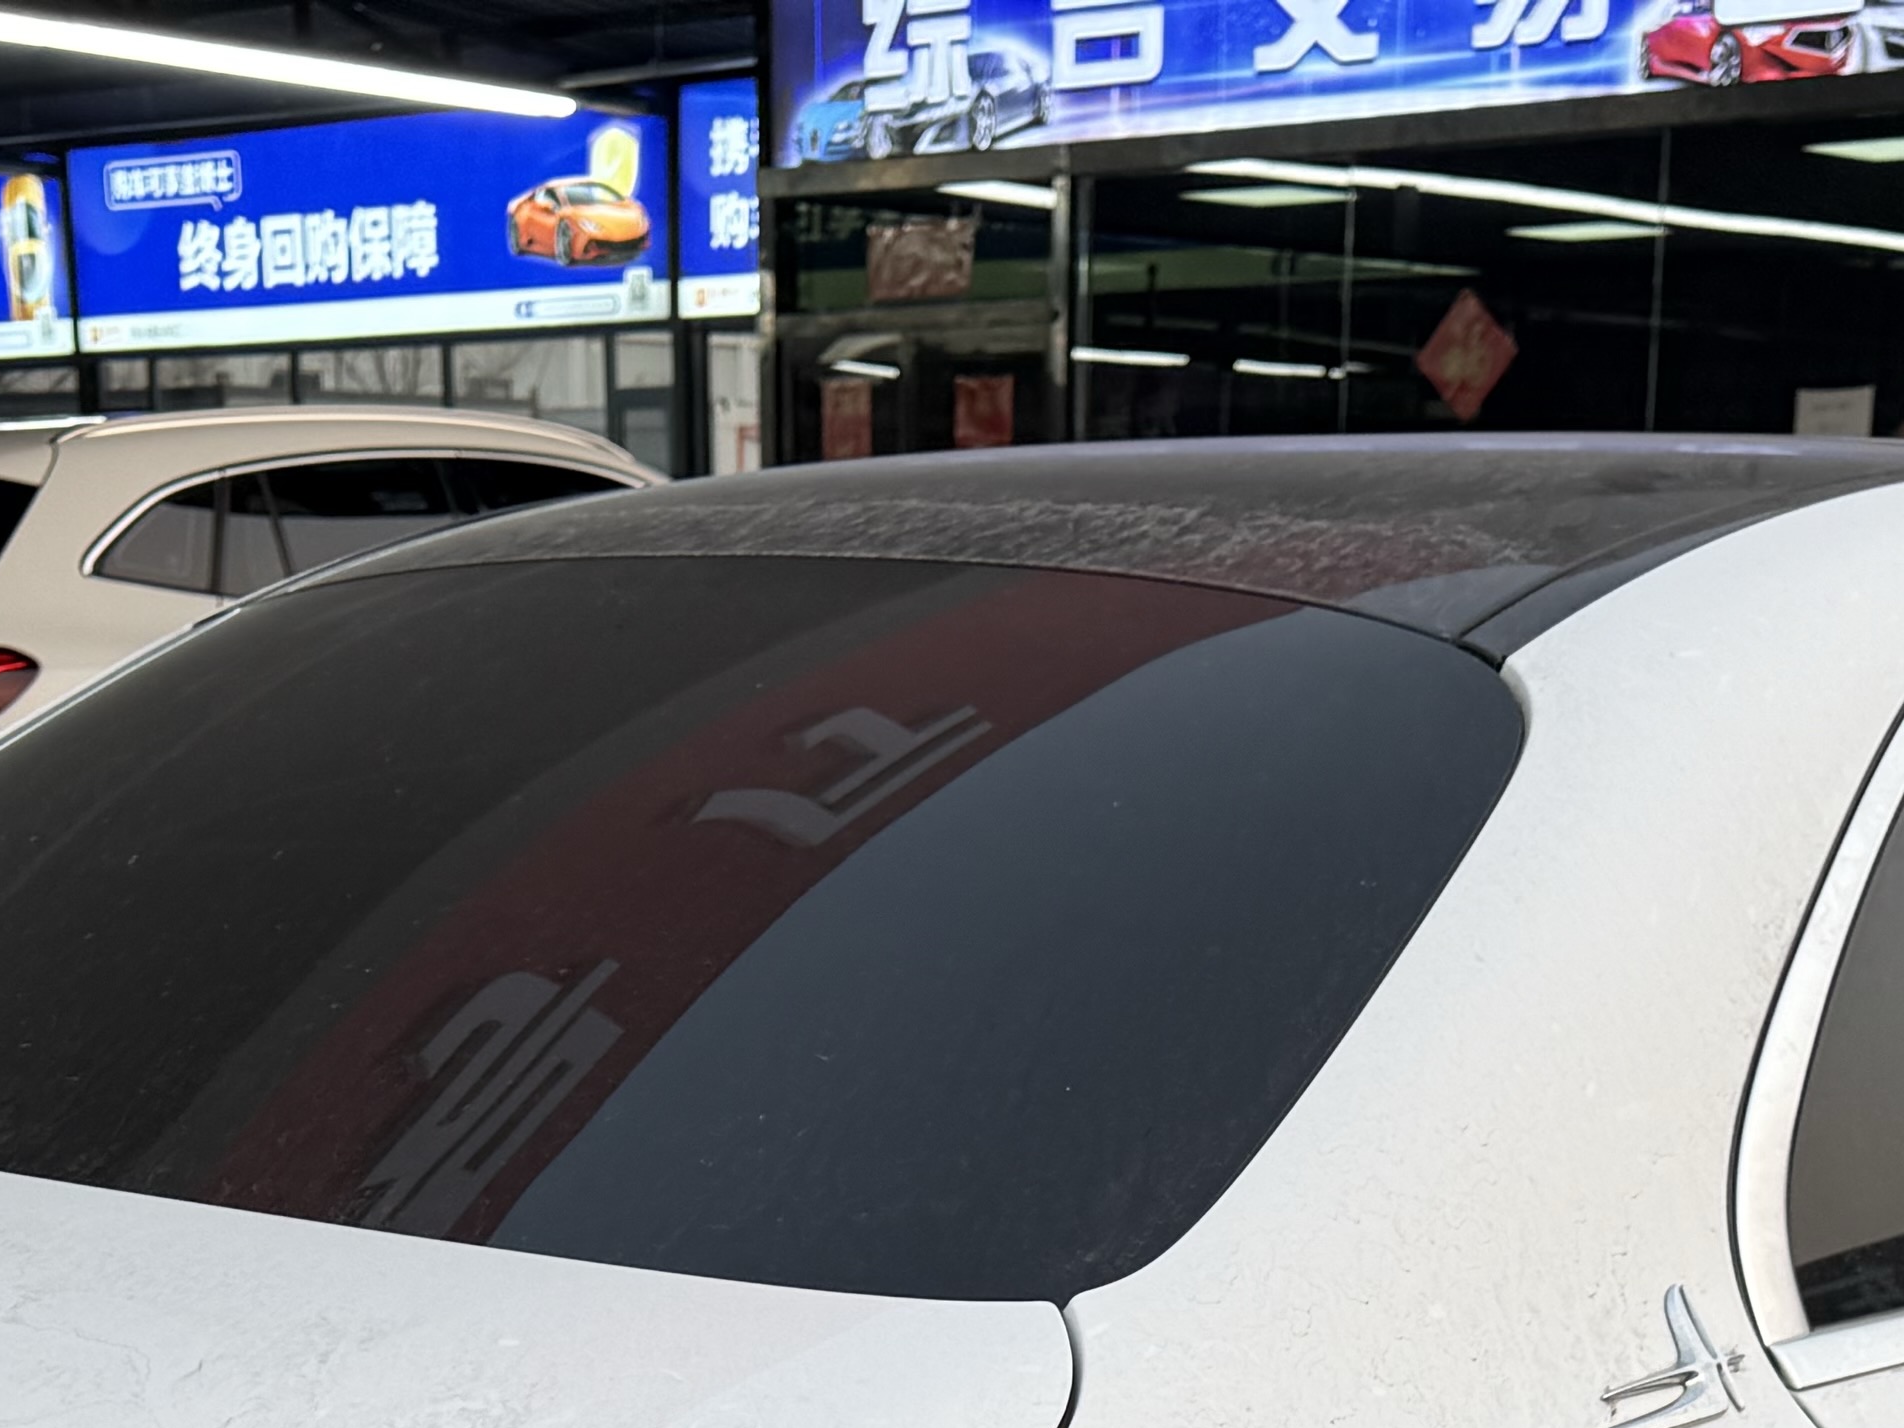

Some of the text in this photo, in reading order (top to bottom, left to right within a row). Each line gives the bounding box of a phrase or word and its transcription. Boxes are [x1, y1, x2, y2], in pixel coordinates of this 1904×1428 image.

[177, 199, 439, 292] 终身回购保障
